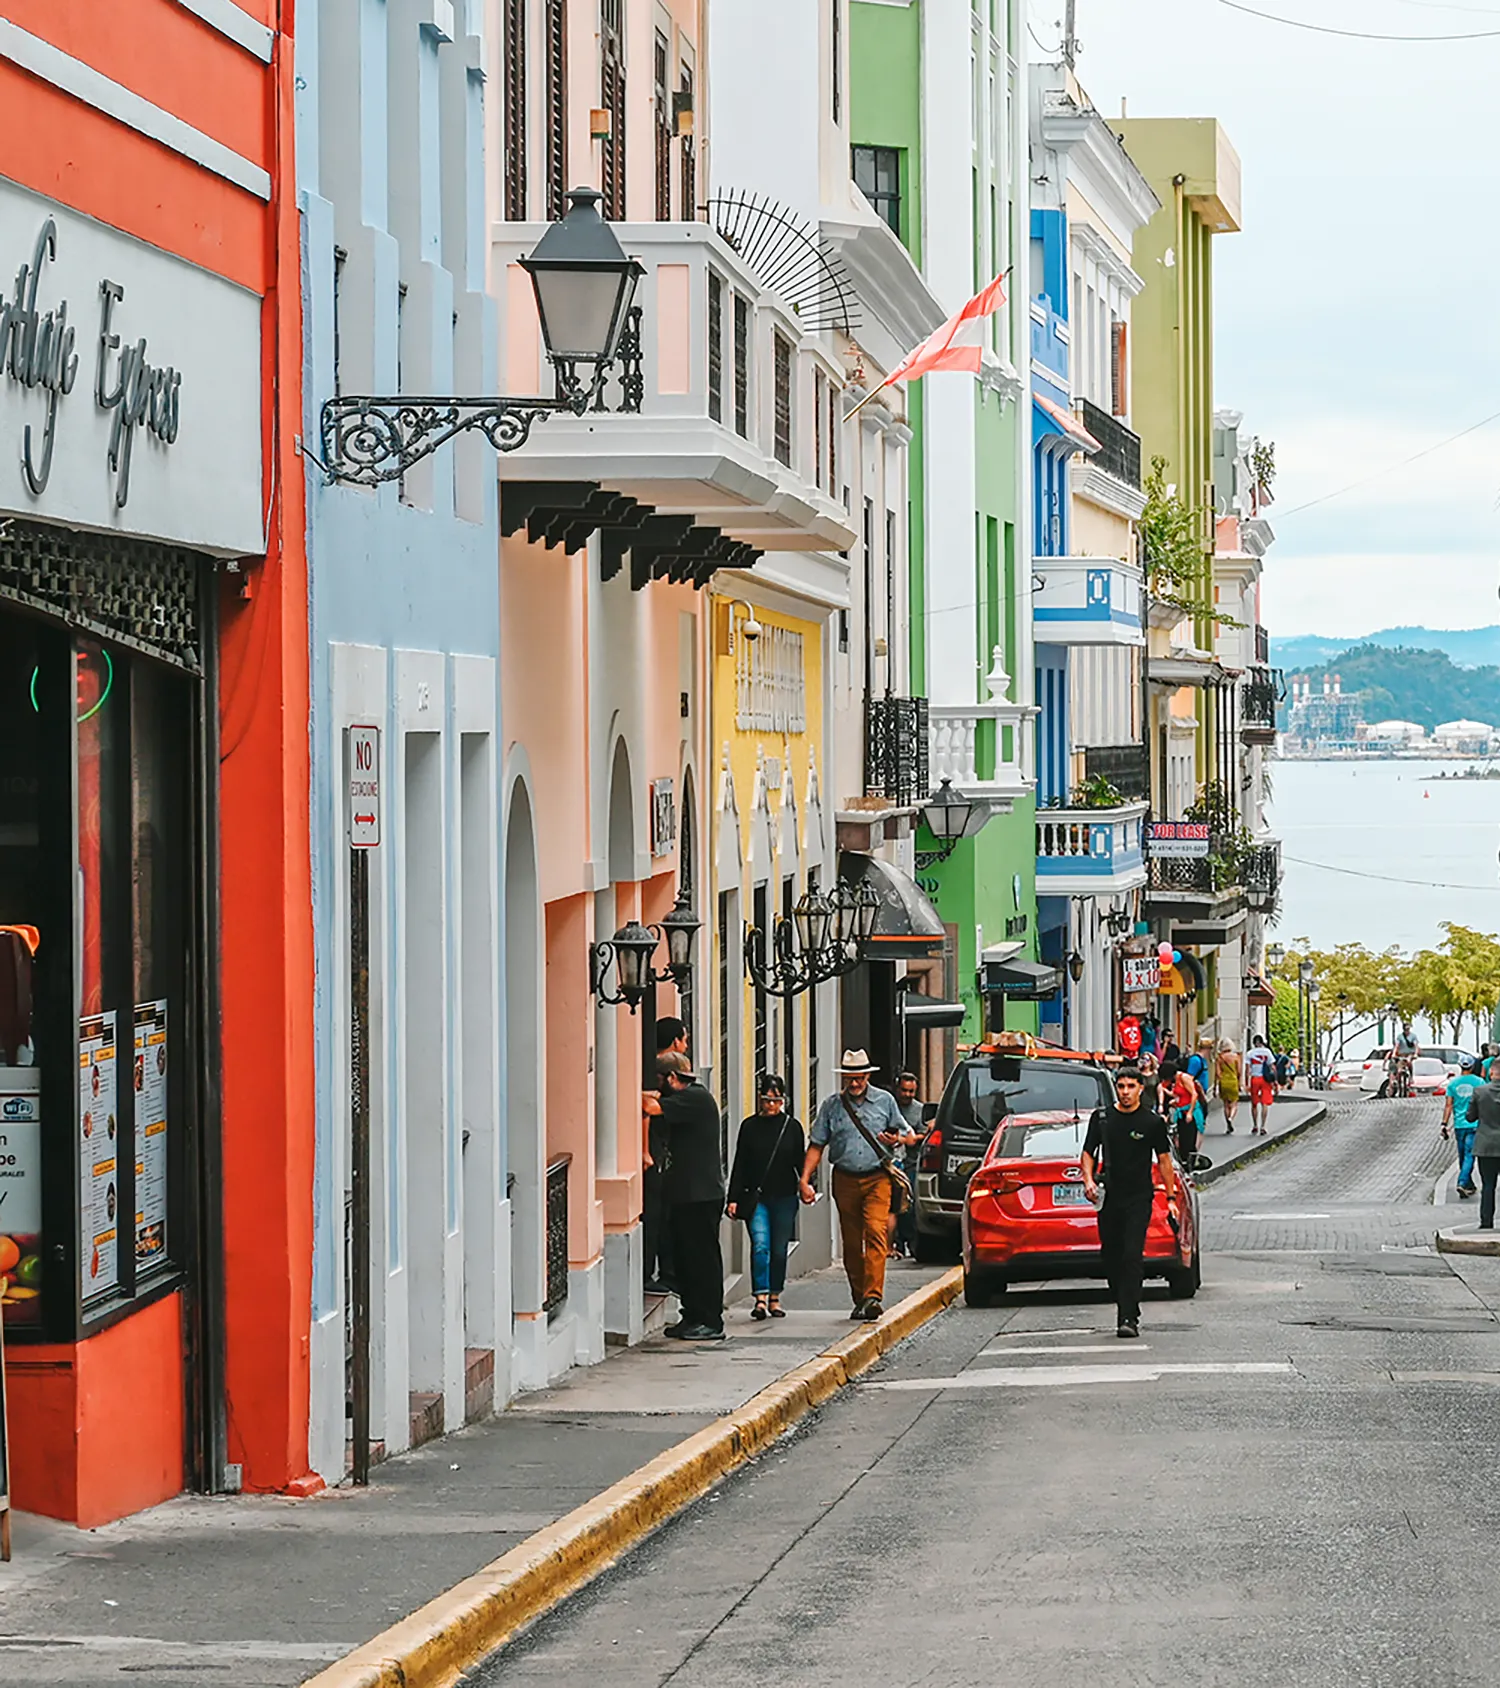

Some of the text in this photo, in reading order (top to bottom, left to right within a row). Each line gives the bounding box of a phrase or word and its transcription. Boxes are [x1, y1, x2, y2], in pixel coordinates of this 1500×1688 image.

[355, 740, 373, 772] NO
[1153, 823, 1209, 839] FOR LEASE
[1124, 971, 1133, 986] 4
[1135, 973, 1144, 986] x
[1146, 968, 1160, 985] 10
